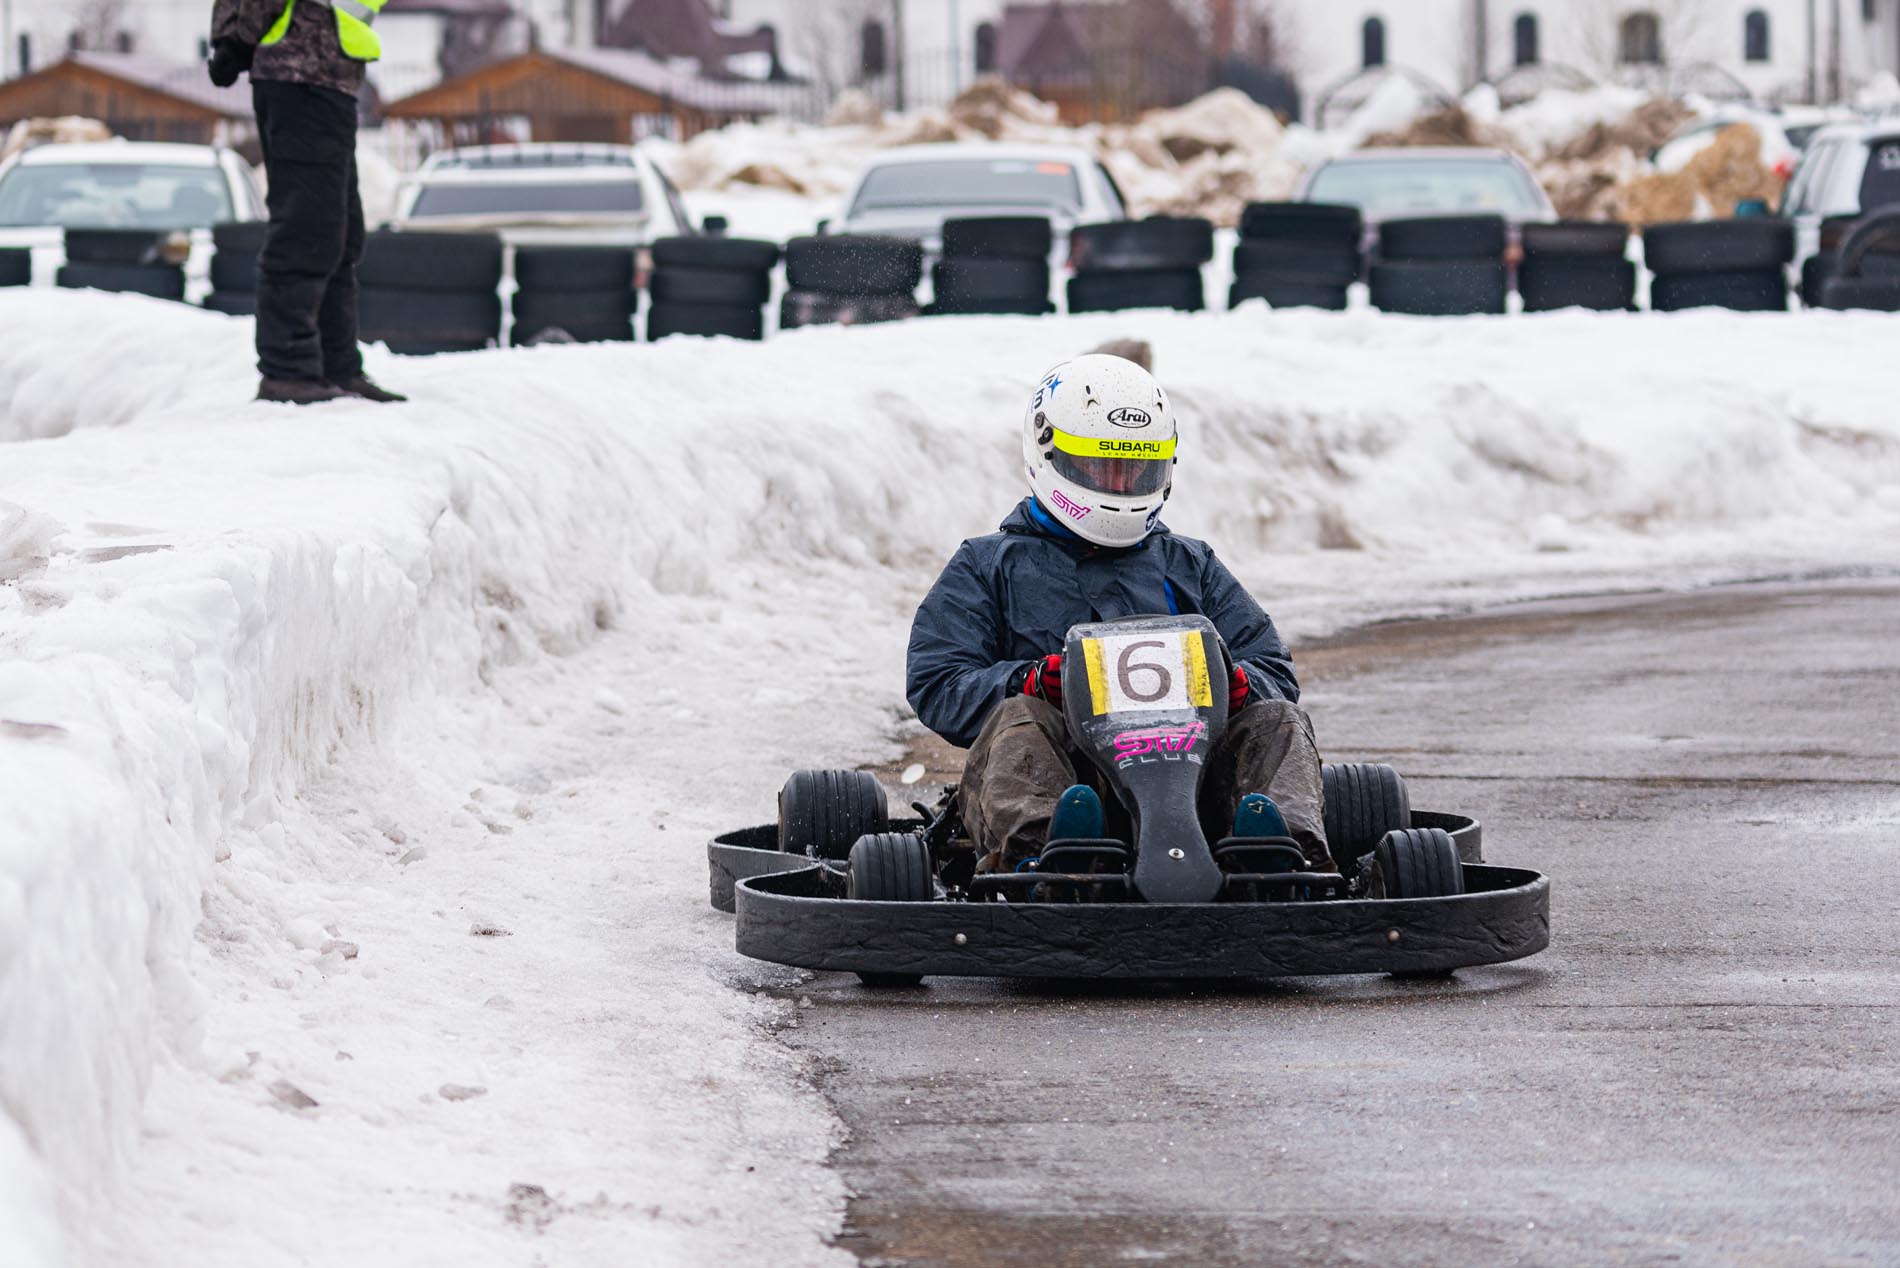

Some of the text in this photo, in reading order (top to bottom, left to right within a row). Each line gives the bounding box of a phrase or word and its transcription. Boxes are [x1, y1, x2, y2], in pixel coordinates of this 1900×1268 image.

[1110, 409, 1147, 423] Arai
[1098, 440, 1160, 452] SUBARU
[1117, 640, 1172, 703] 6
[1119, 753, 1203, 769] CLUB
